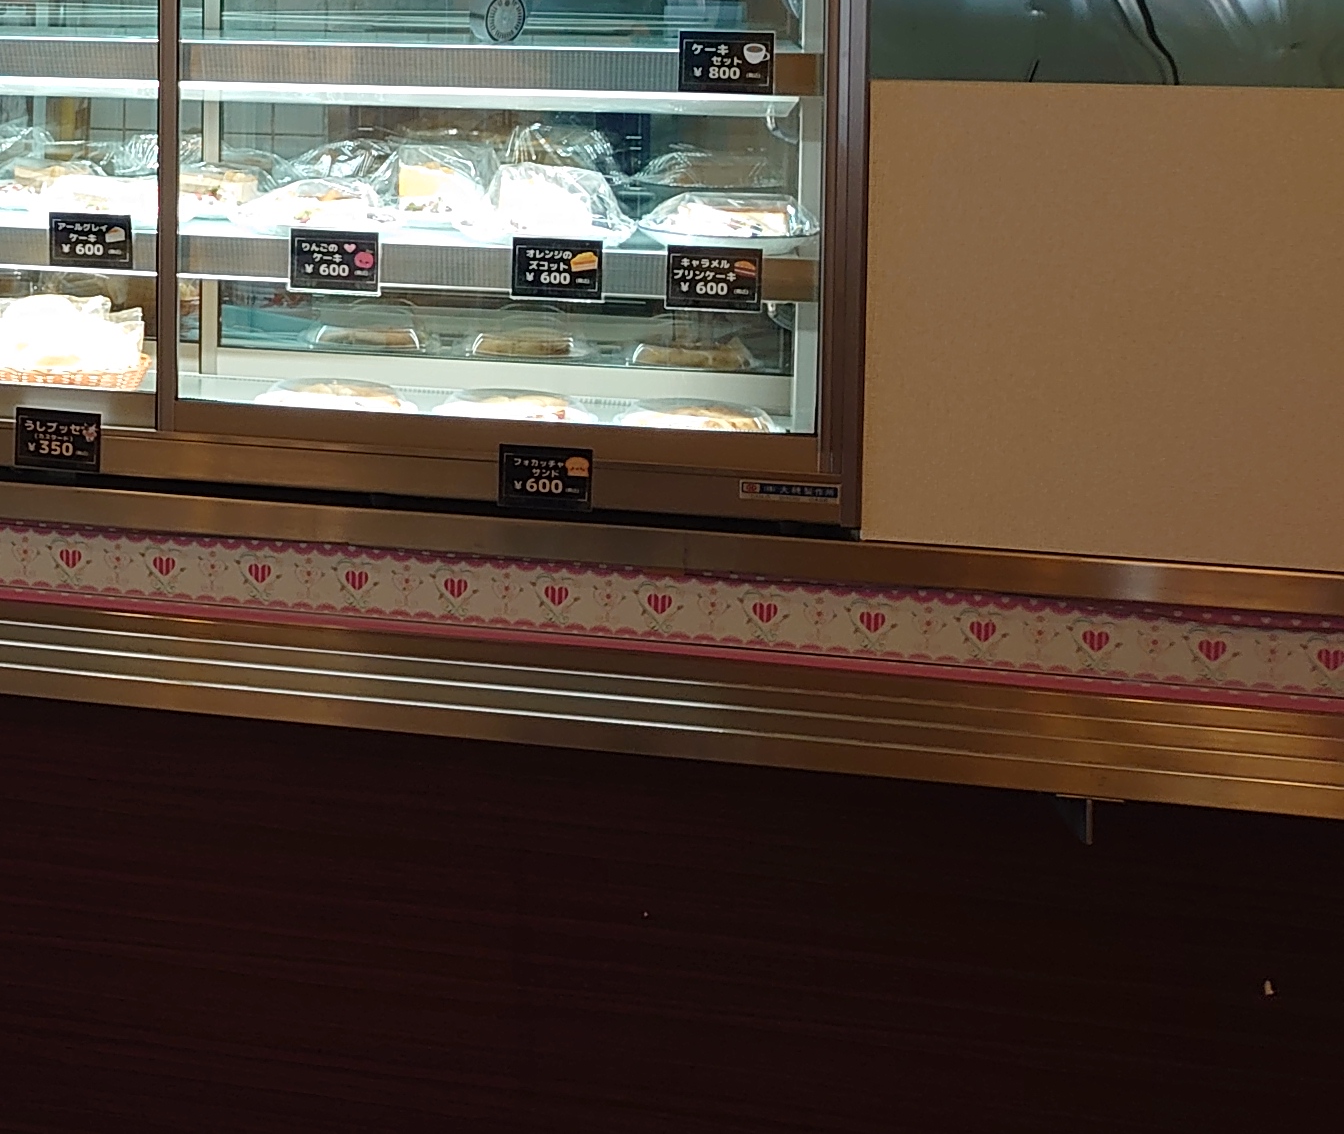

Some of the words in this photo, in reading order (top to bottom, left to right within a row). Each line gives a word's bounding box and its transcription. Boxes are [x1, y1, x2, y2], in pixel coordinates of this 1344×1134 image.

[692, 43, 729, 56] ケーキ
[711, 56, 742, 66] セット
[57, 222, 108, 232] アールグレイ
[69, 232, 98, 243] ケーキ
[301, 242, 339, 252] りんごの
[312, 253, 343, 263] ケーキ
[525, 249, 572, 260] オレンジの
[680, 257, 730, 269] キャラメル
[673, 269, 737, 282] プリンケーキ
[24, 420, 80, 435] うしブッセ
[513, 457, 564, 468] フォカッチャ
[532, 468, 559, 477] サンド
